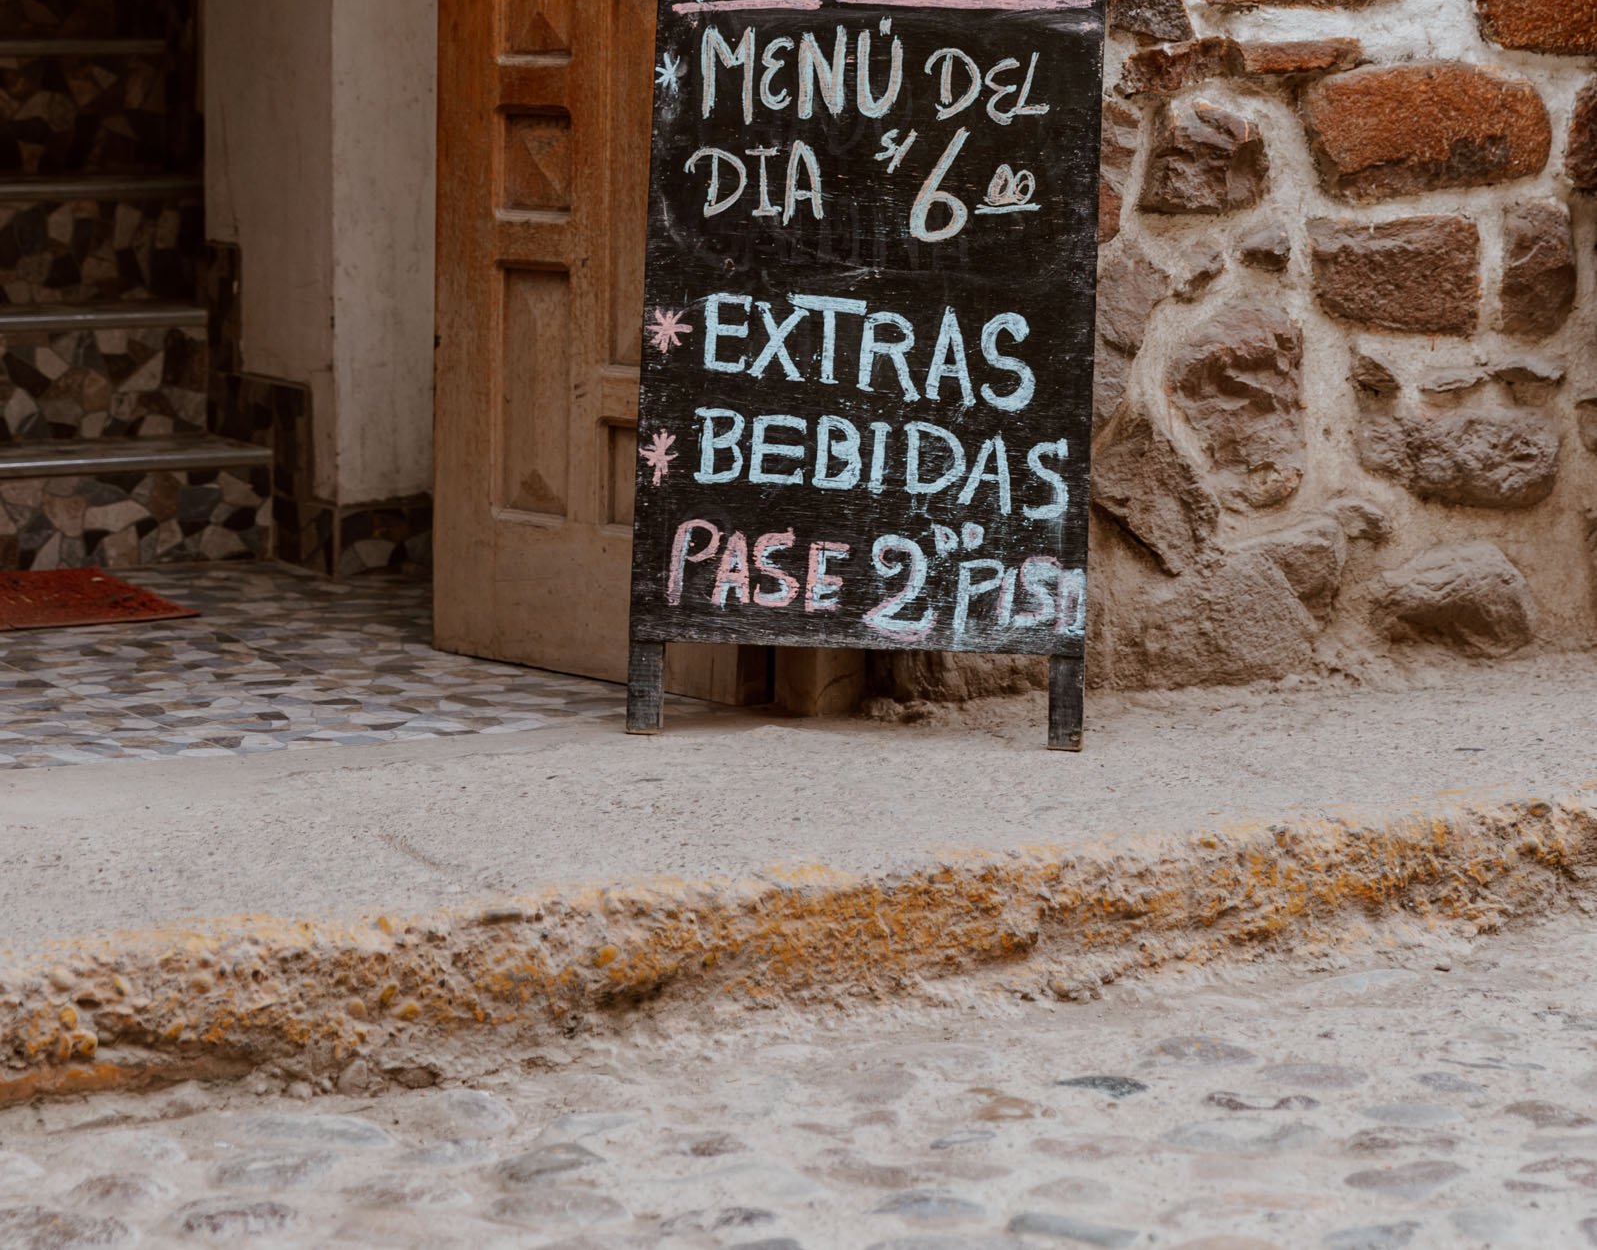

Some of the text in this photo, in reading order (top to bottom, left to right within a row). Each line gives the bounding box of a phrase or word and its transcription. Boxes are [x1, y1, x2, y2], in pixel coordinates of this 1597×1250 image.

[924, 47, 1050, 124] DEL
[684, 140, 823, 226] DIA
[703, 292, 1036, 412] EXTRAS
[693, 407, 1069, 520] BEBIDAS
[667, 519, 850, 612] PASE
[952, 556, 1087, 650] PISO
